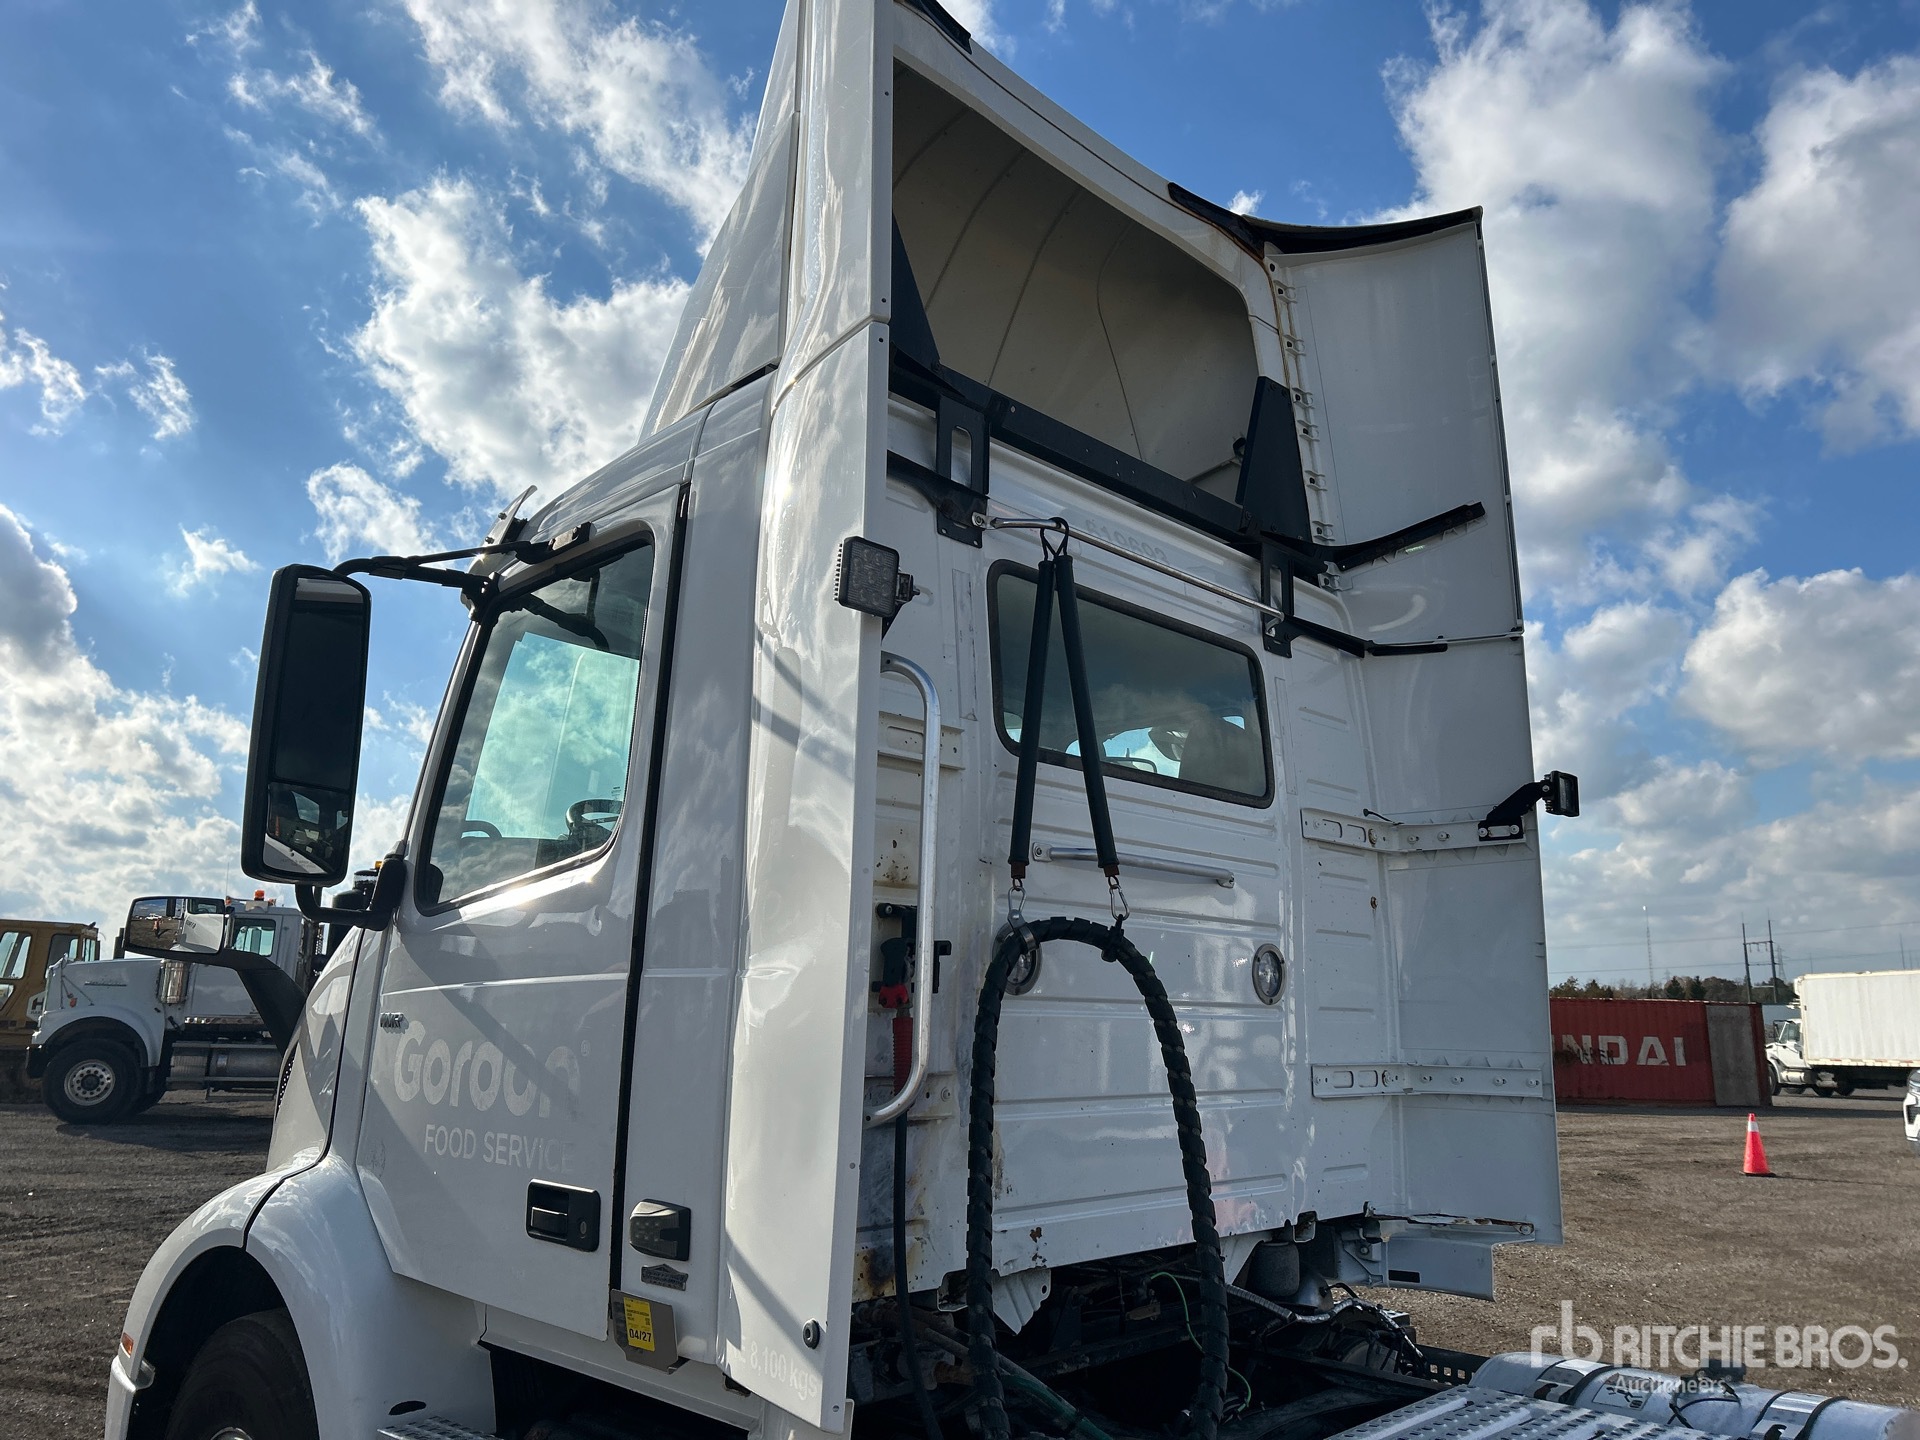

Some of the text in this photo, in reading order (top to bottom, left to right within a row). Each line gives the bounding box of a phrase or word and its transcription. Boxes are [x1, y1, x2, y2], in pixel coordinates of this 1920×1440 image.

[1552, 1034, 1687, 1067] NDAI
[424, 1124, 575, 1173] FOOD SERVICE
[629, 1329, 652, 1343] 04/27
[789, 1358, 818, 1401] kgs
